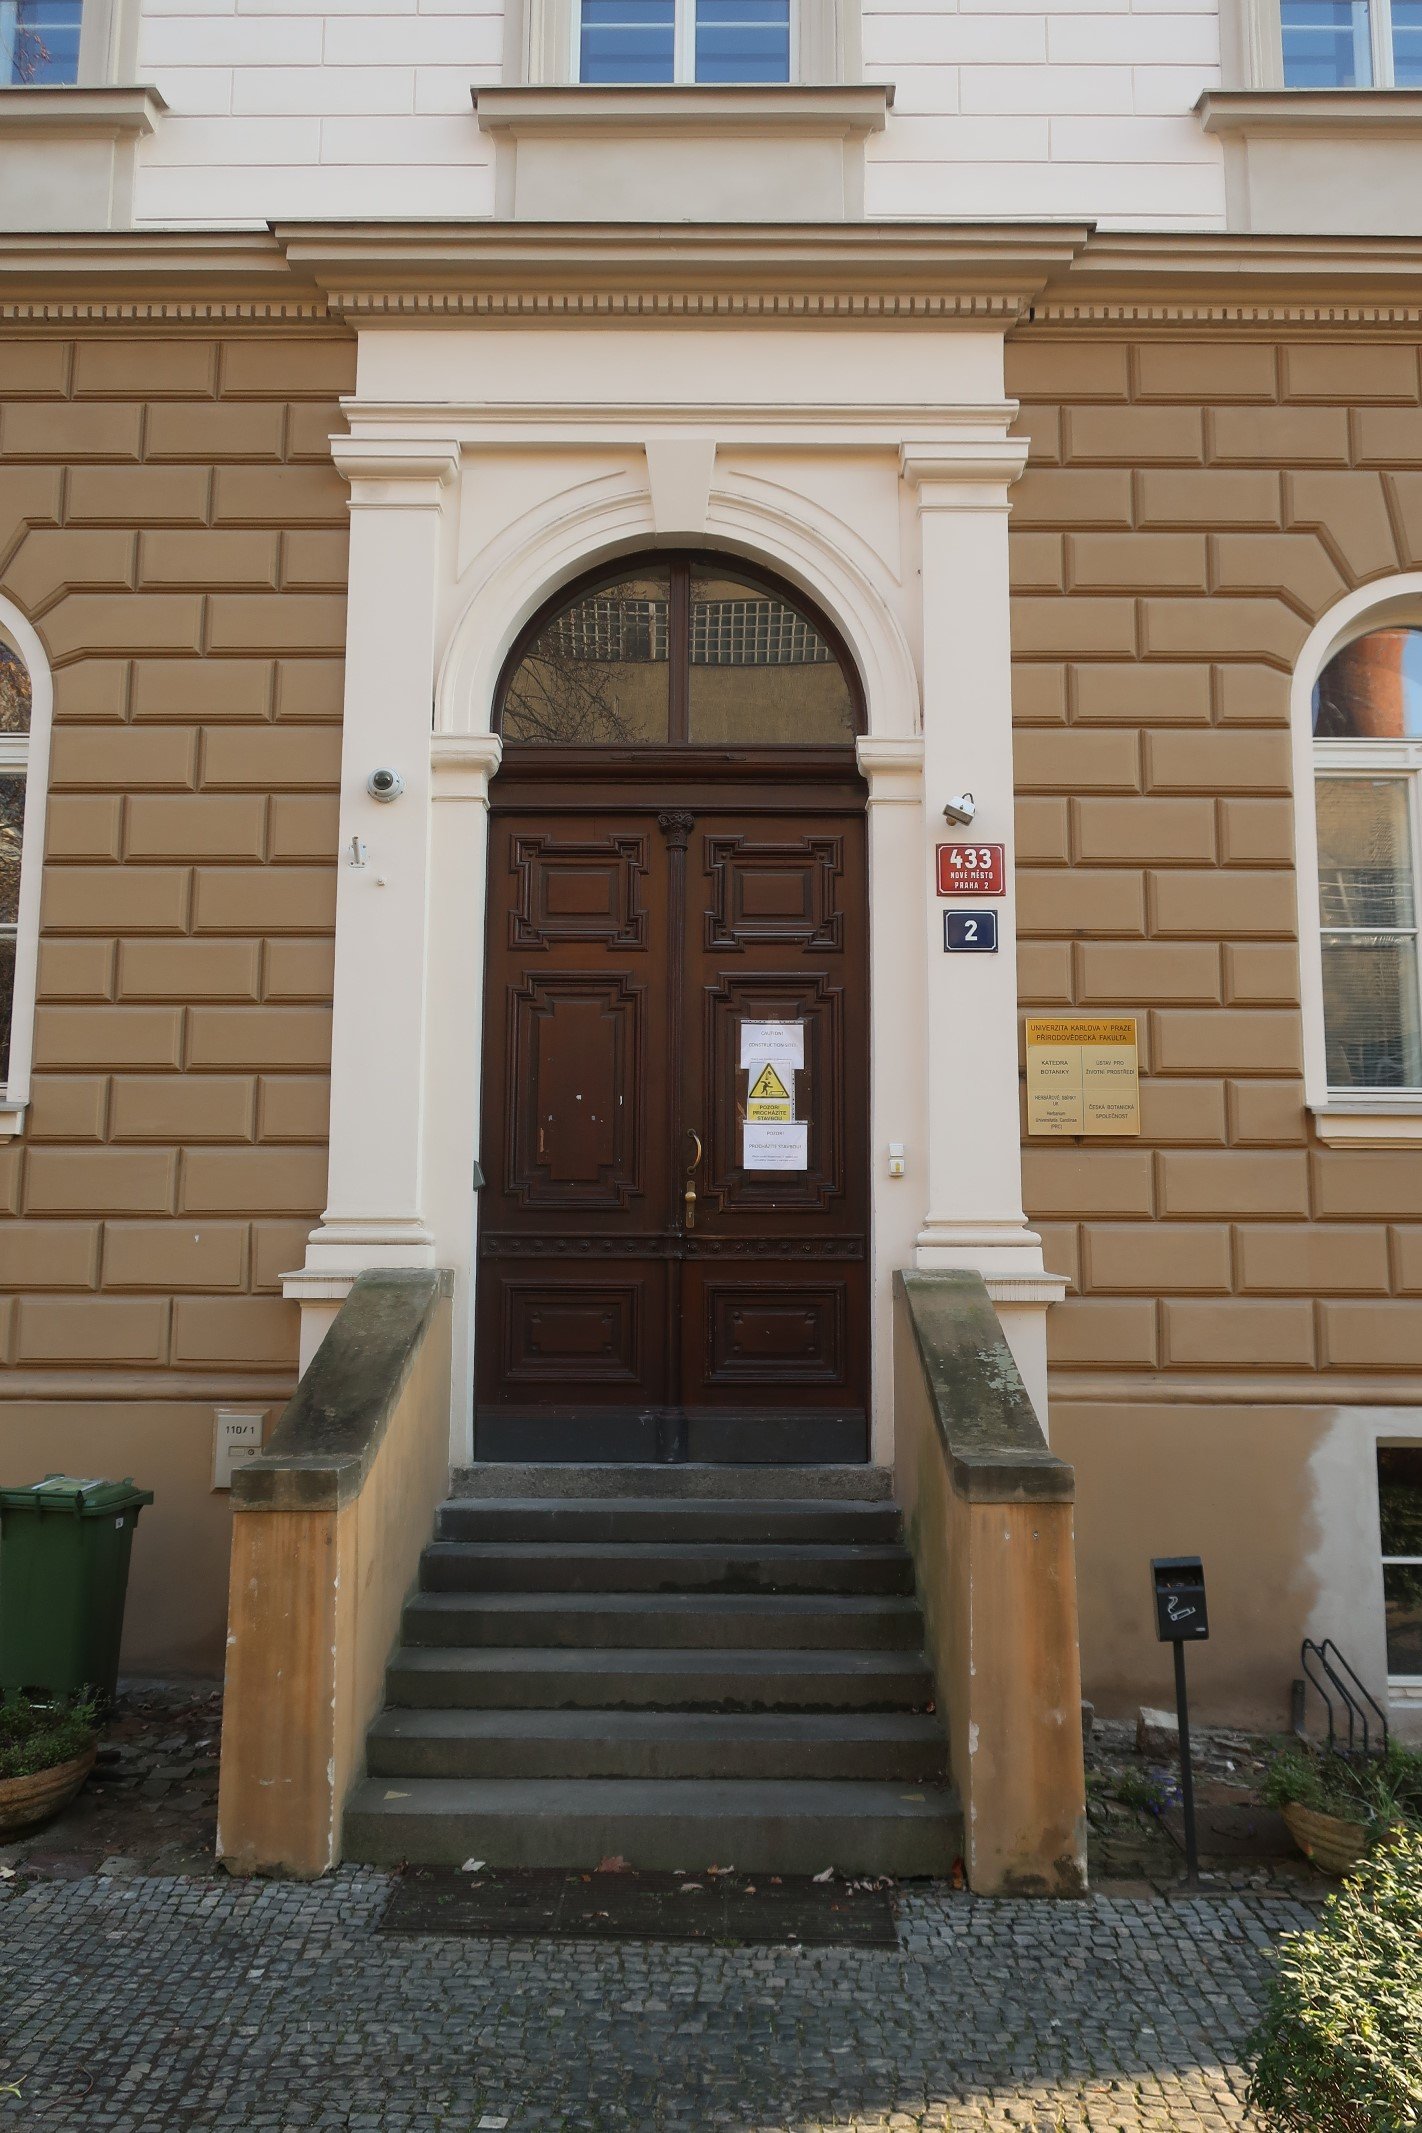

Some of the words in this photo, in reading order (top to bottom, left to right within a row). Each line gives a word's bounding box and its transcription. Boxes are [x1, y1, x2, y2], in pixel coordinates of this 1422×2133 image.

[950, 848, 992, 869] 433
[950, 870, 968, 879] NOVÉ
[970, 869, 993, 879] MĚSTO
[964, 920, 978, 941] 2
[1036, 1033, 1097, 1041] PŘÍRODOVĚDECKÁ
